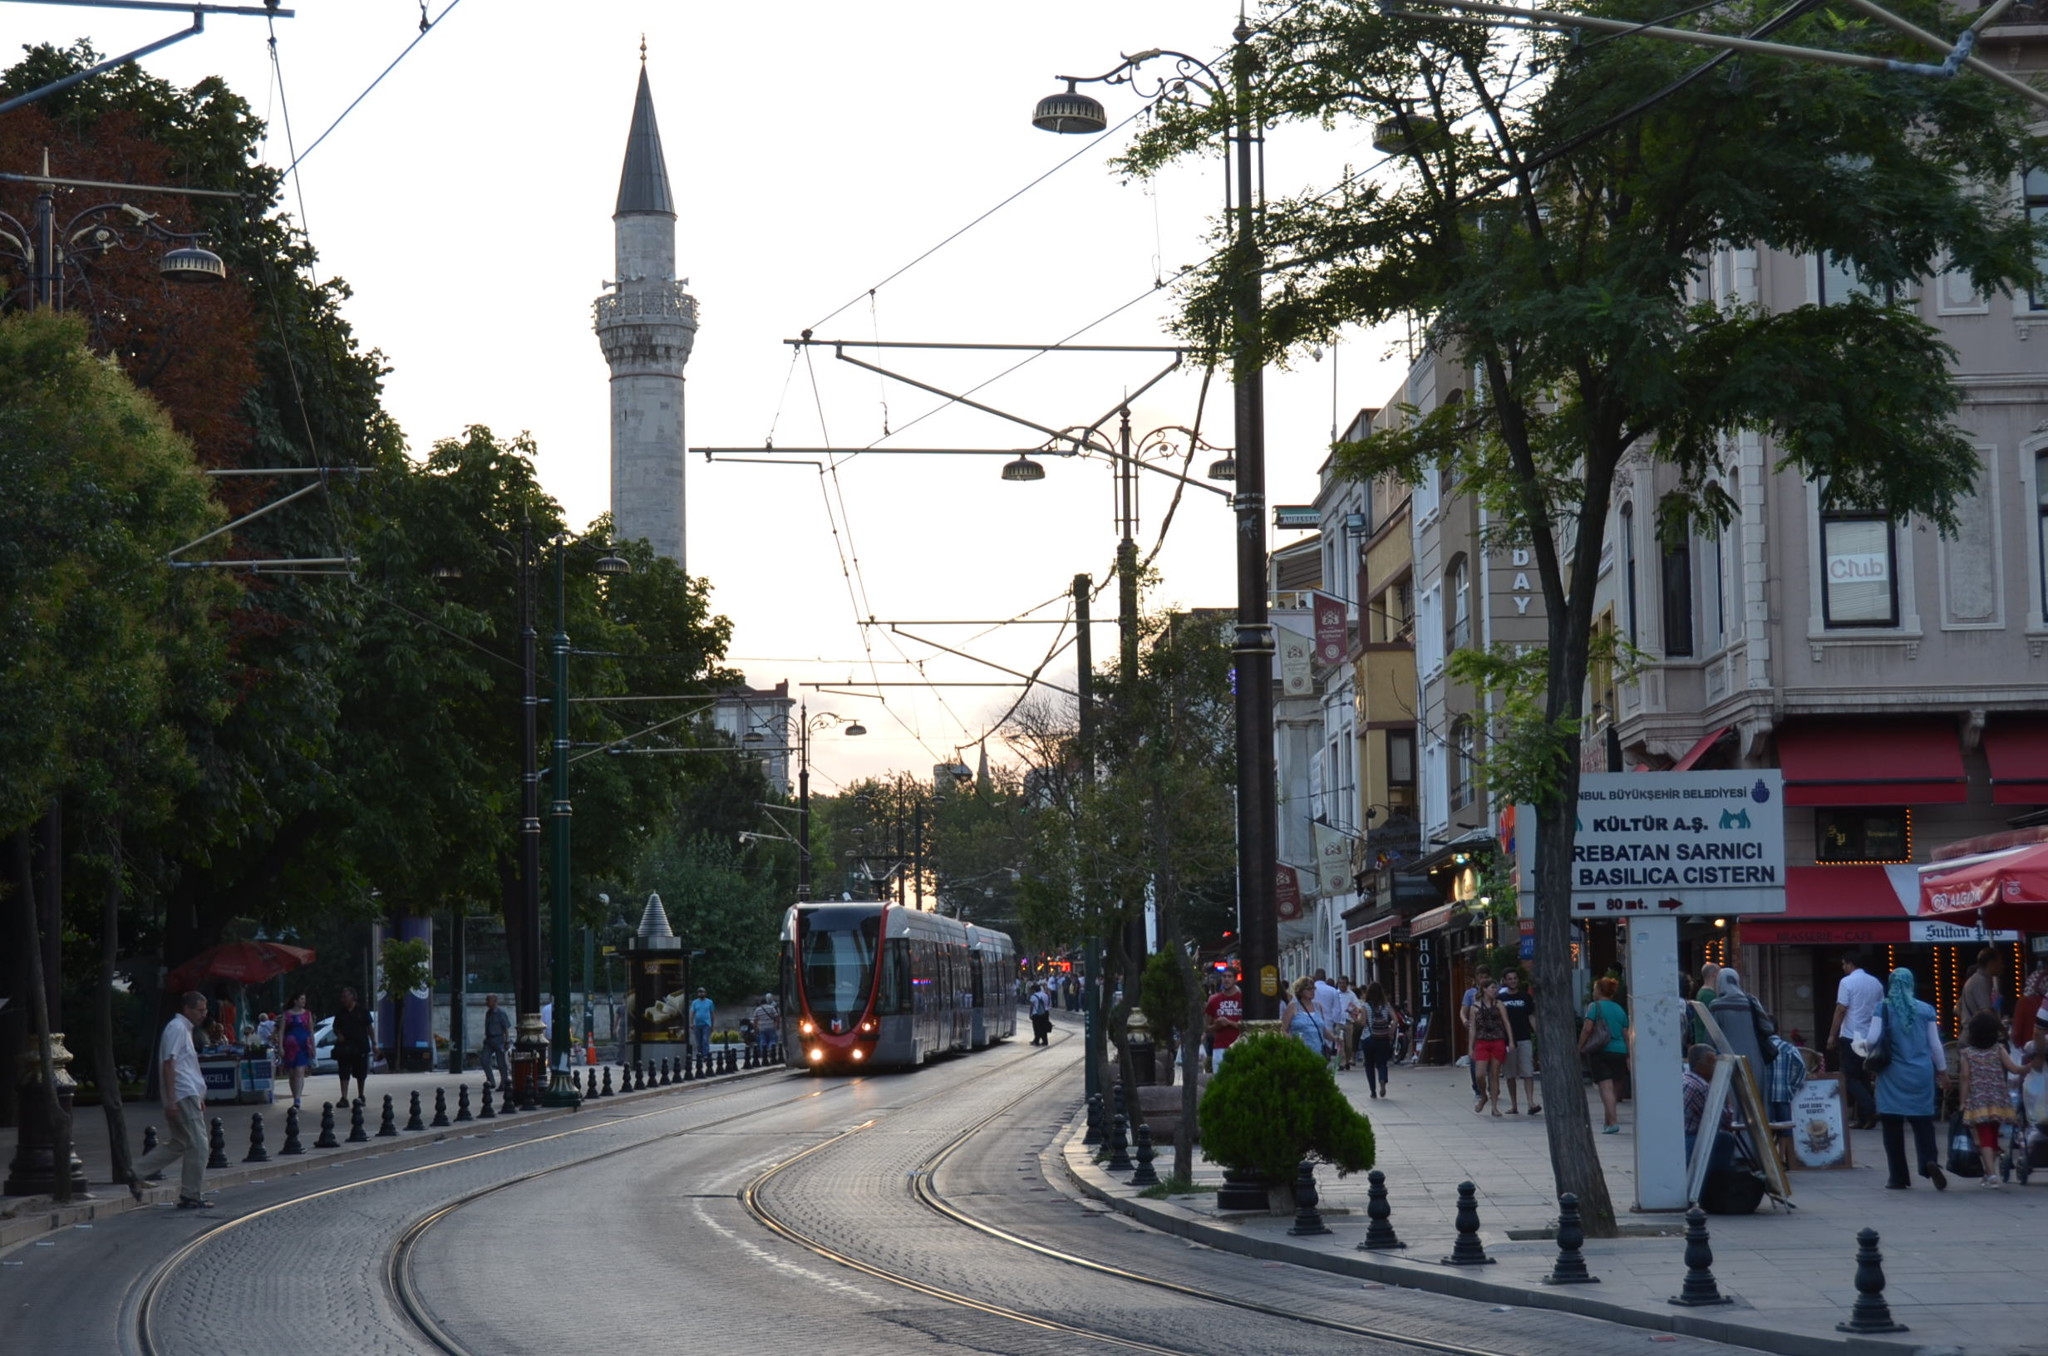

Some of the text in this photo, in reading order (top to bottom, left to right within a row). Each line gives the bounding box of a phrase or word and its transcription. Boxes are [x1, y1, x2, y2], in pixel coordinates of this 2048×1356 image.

[1512, 549, 1531, 615] DAY
[1577, 786, 1747, 801] NBUL BÜYÜKŞEHİR BELEDİYESİ
[1593, 815, 1709, 833] KÜLTÜR A.Ş.
[1572, 841, 1762, 862] REBATAN SARNICI
[1580, 866, 1679, 886] BASILICA
[1684, 865, 1775, 884] CISTERN
[1606, 898, 1623, 910] 80
[1926, 924, 1970, 941] Sultan
[1419, 939, 1432, 1007] HOTEL
[204, 1073, 231, 1084] KCELL
